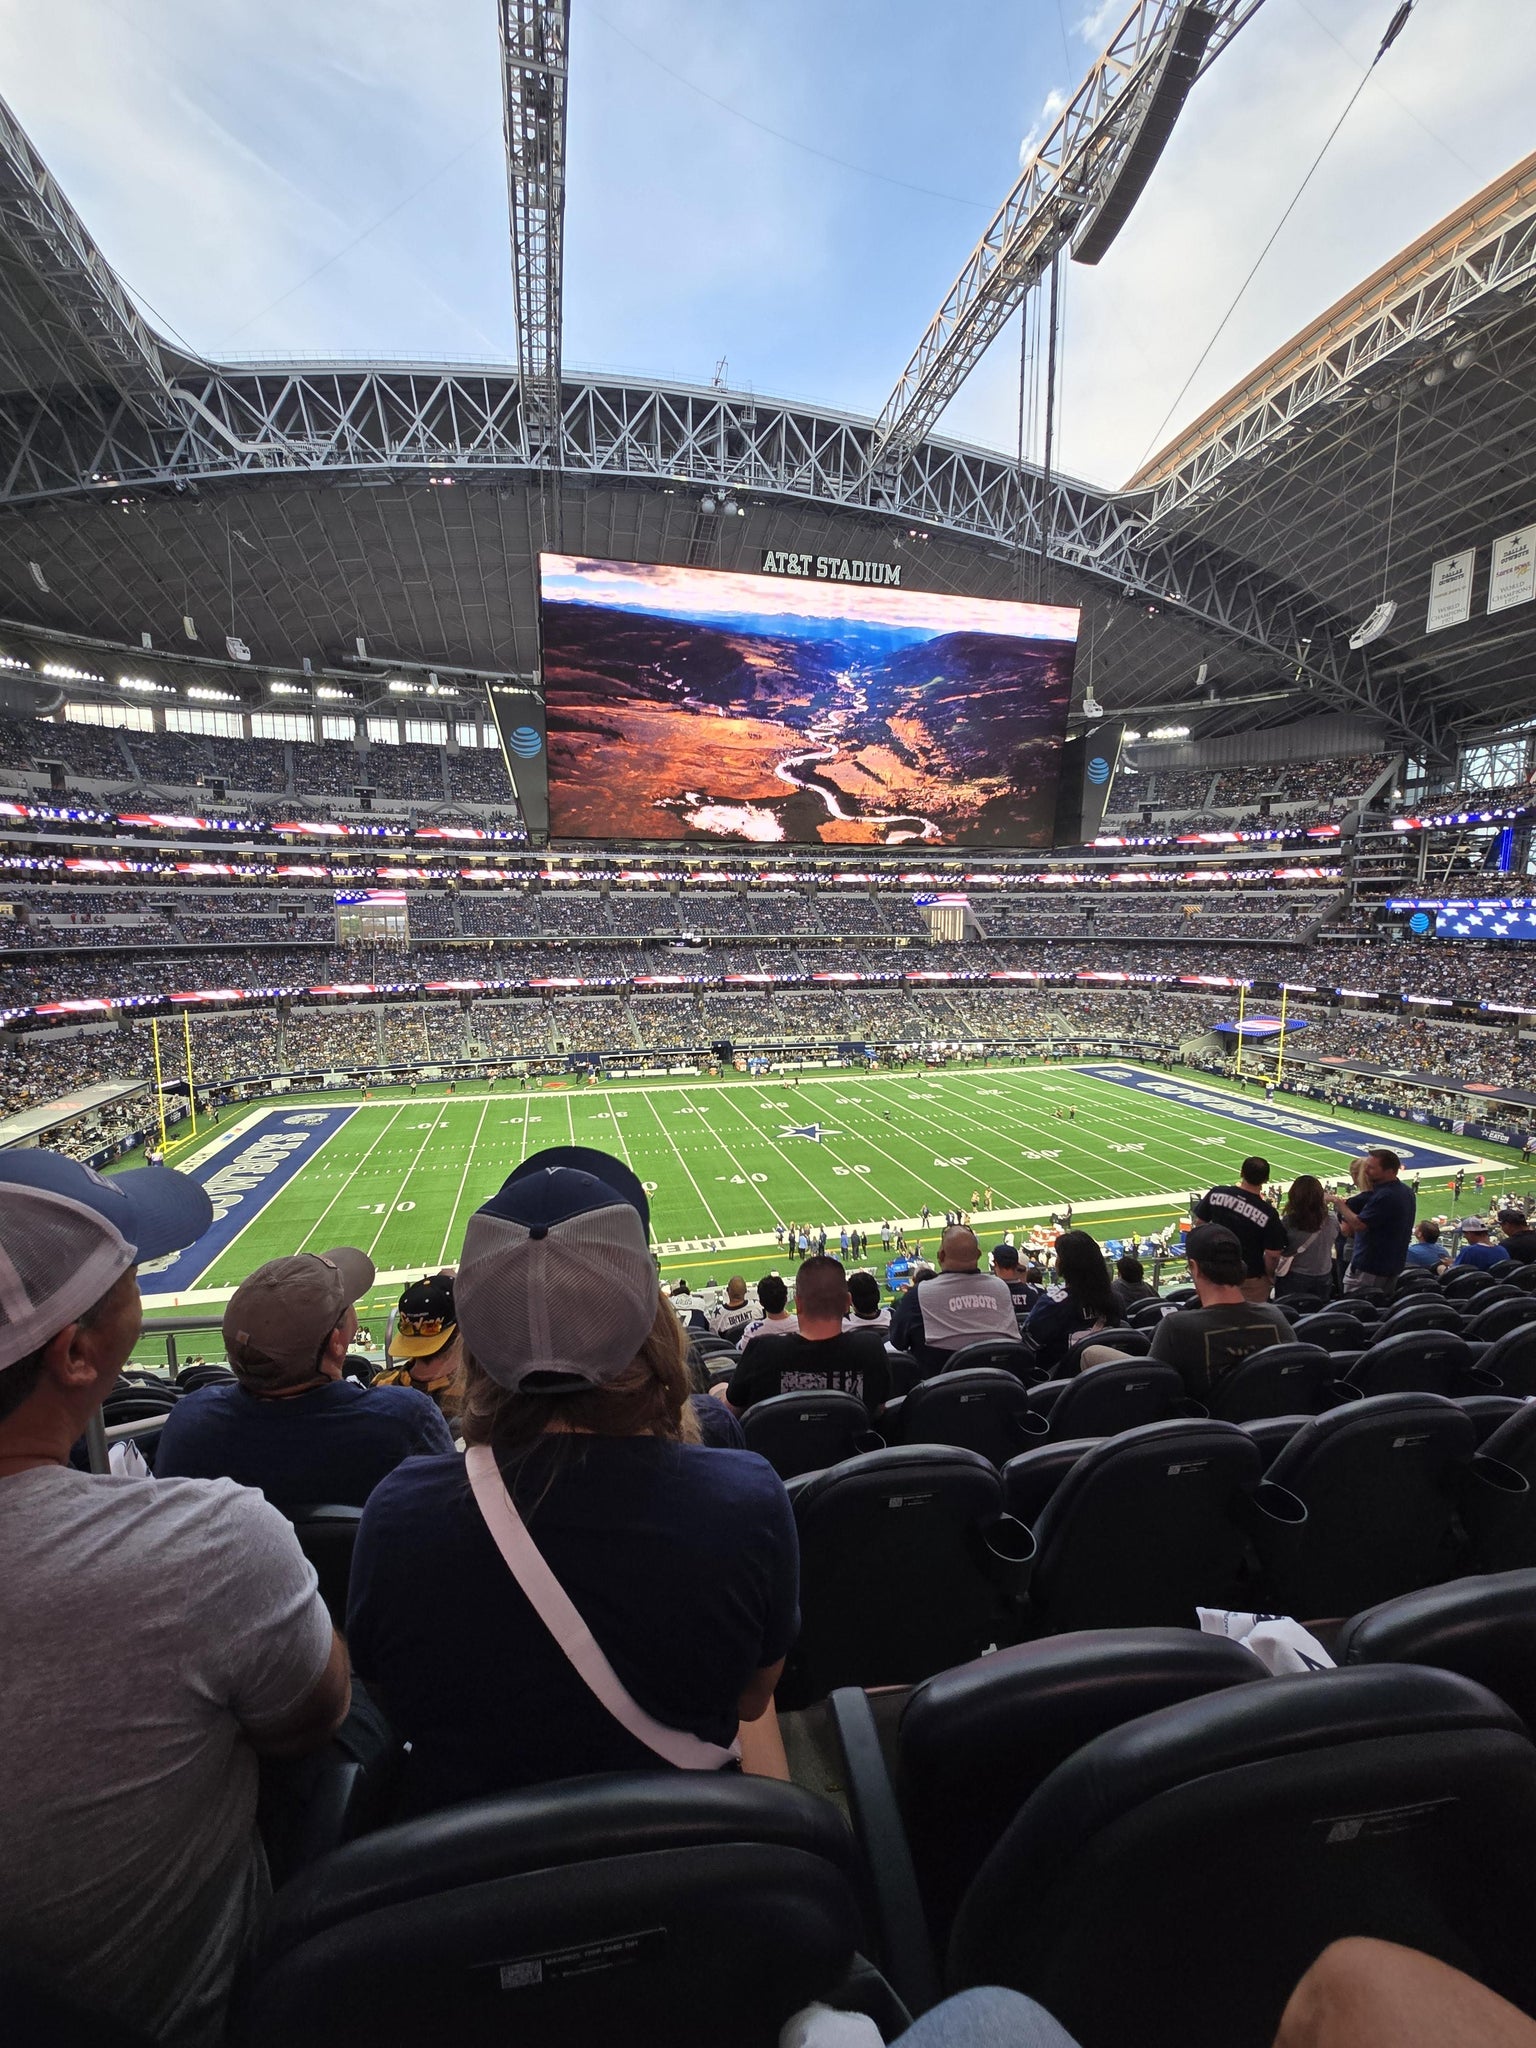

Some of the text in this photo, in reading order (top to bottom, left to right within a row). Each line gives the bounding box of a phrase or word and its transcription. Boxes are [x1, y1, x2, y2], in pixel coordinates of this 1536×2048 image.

[1500, 549, 1529, 564] COWBOYS
[762, 550, 902, 586] AT&T STADIUM
[1492, 585, 1532, 602] CHAMPIONS
[1500, 581, 1525, 593] WORLD
[1430, 607, 1466, 622] CHAMPIONS
[1136, 1081, 1338, 1135] COWBOYS
[933, 1156, 968, 1168] 40
[832, 1164, 871, 1176] 50
[729, 1172, 768, 1184] 40
[641, 1181, 658, 1191] 0
[369, 1200, 416, 1215] 10
[1209, 1192, 1269, 1228] COWBOYS
[948, 1294, 998, 1313] COWBOYS
[728, 1310, 753, 1326] BRYANT
